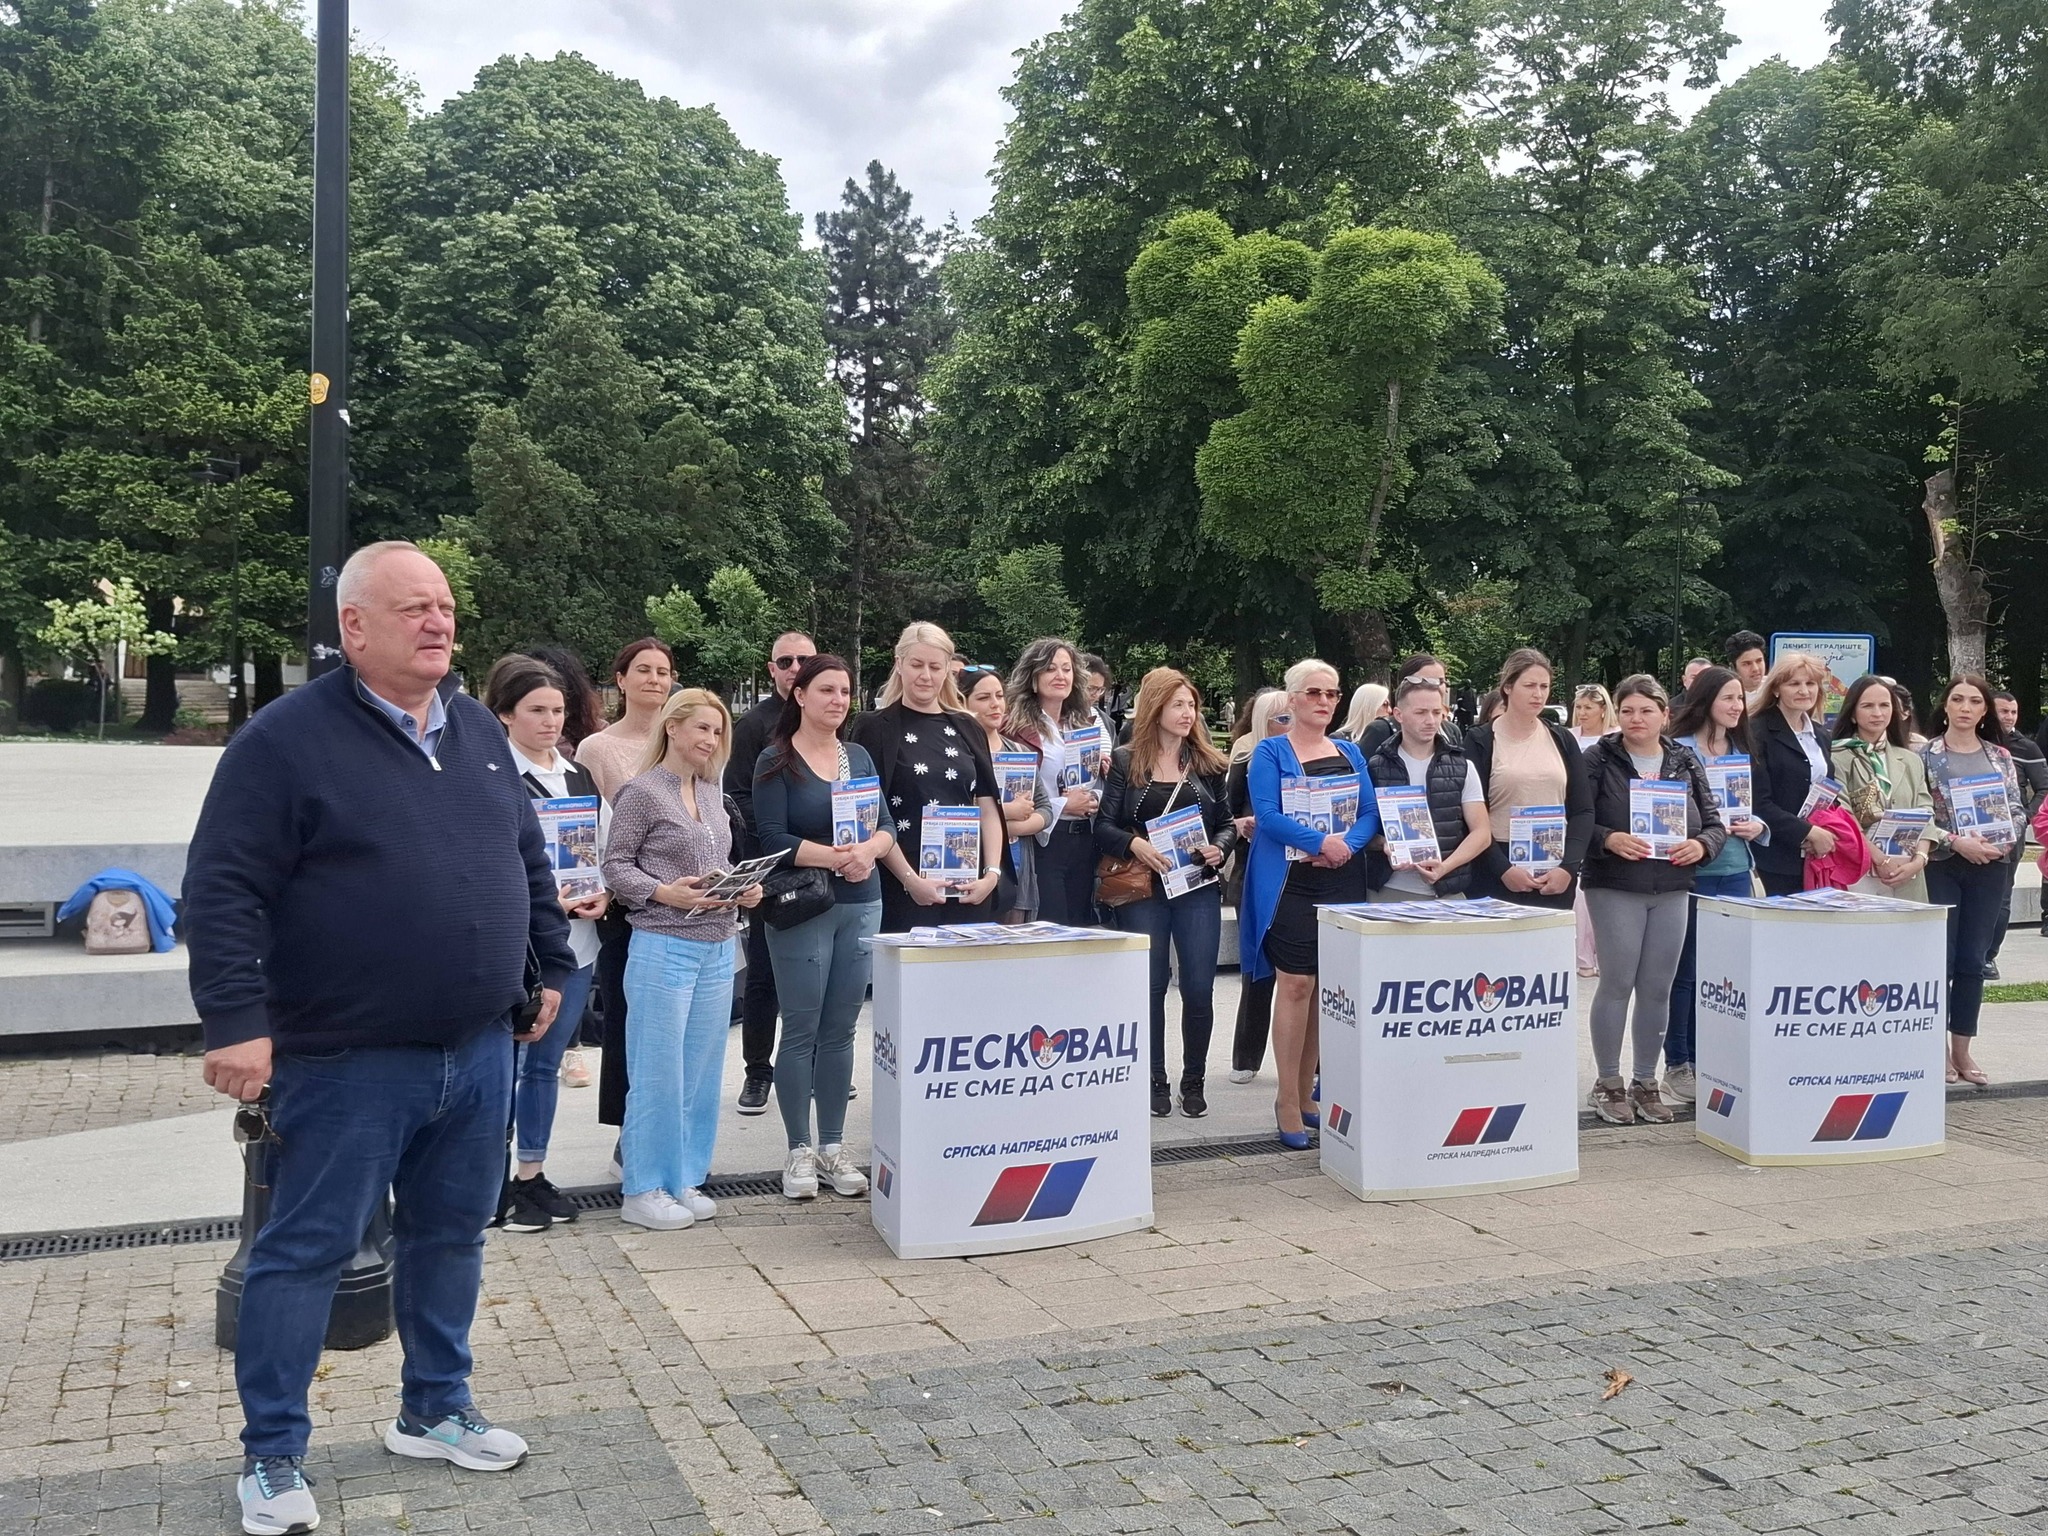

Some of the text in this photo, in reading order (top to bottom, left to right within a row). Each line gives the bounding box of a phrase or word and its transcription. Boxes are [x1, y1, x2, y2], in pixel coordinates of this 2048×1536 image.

[1322, 984, 1356, 1019] СРБИЈА
[1371, 971, 1569, 1014] ЛЕСКВАЦ
[1701, 976, 1746, 1011] СРБИЈА
[1765, 979, 1939, 1016] ЛЕСКВАЦ
[1382, 1011, 1563, 1038] НЕ СМЕ ДА СТАНЕ!
[1774, 1016, 1934, 1038] НЕ СМЕ ДА СТАНЕ!
[914, 1022, 1138, 1074] ЛЕСКВАЦ
[925, 1065, 1131, 1100] НЕ СМЕ ДА СТАНЕ!
[1788, 1070, 1925, 1086] СРПСКА НАПРЕДНА СТРАНКА
[943, 1129, 1119, 1159] СРПСКА НАПРЕДНА СТРАНКА
[1427, 1144, 1533, 1161] СРПСКА НАПРЕДНА СТРАНКА
